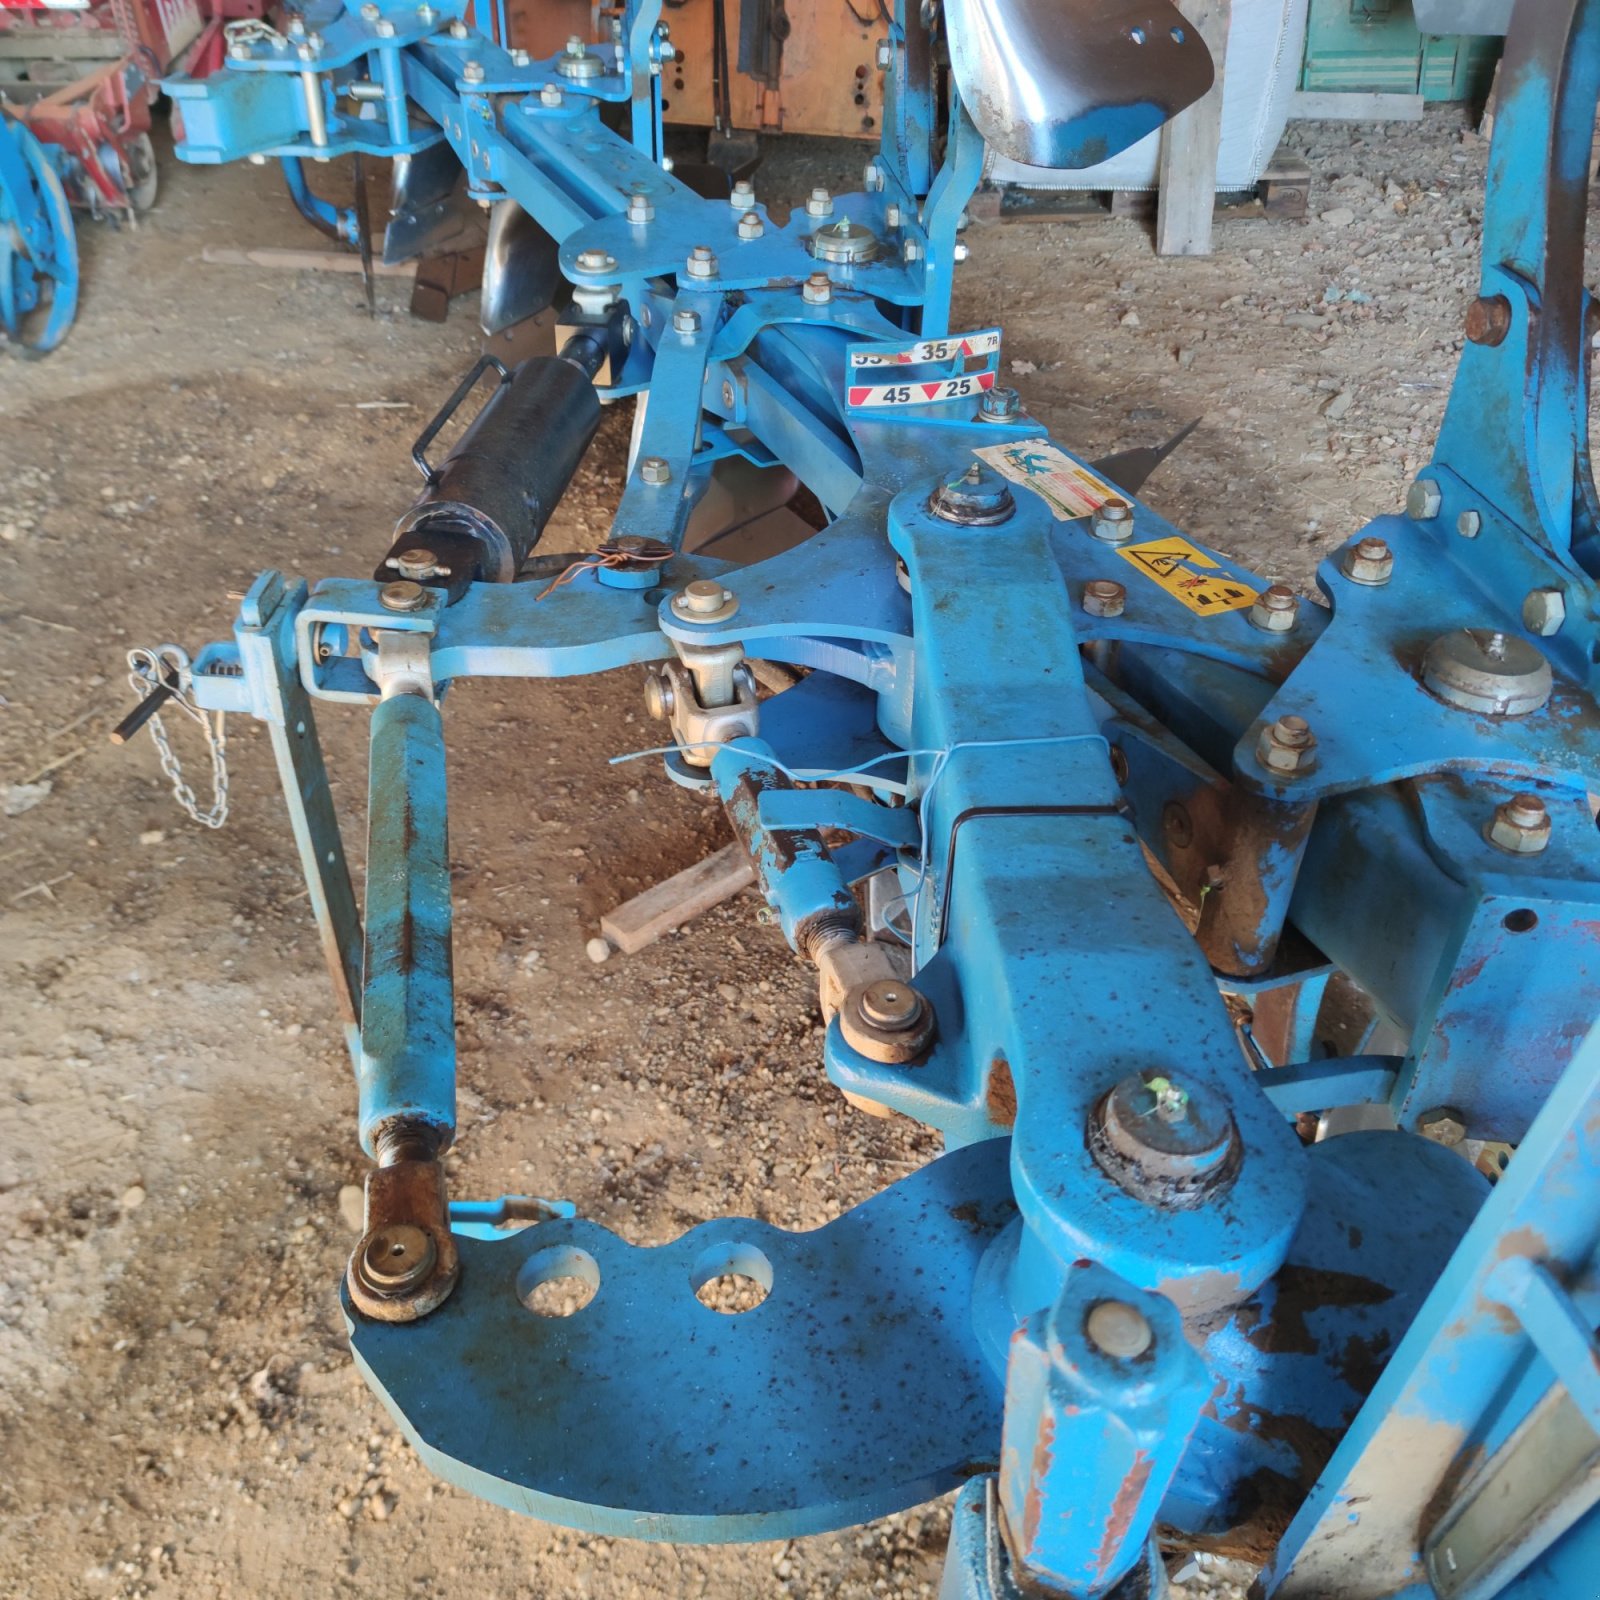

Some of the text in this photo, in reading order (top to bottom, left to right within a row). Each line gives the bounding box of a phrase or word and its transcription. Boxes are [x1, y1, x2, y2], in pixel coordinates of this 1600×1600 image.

[921, 343, 948, 360] 35
[883, 379, 970, 403] 45 25
